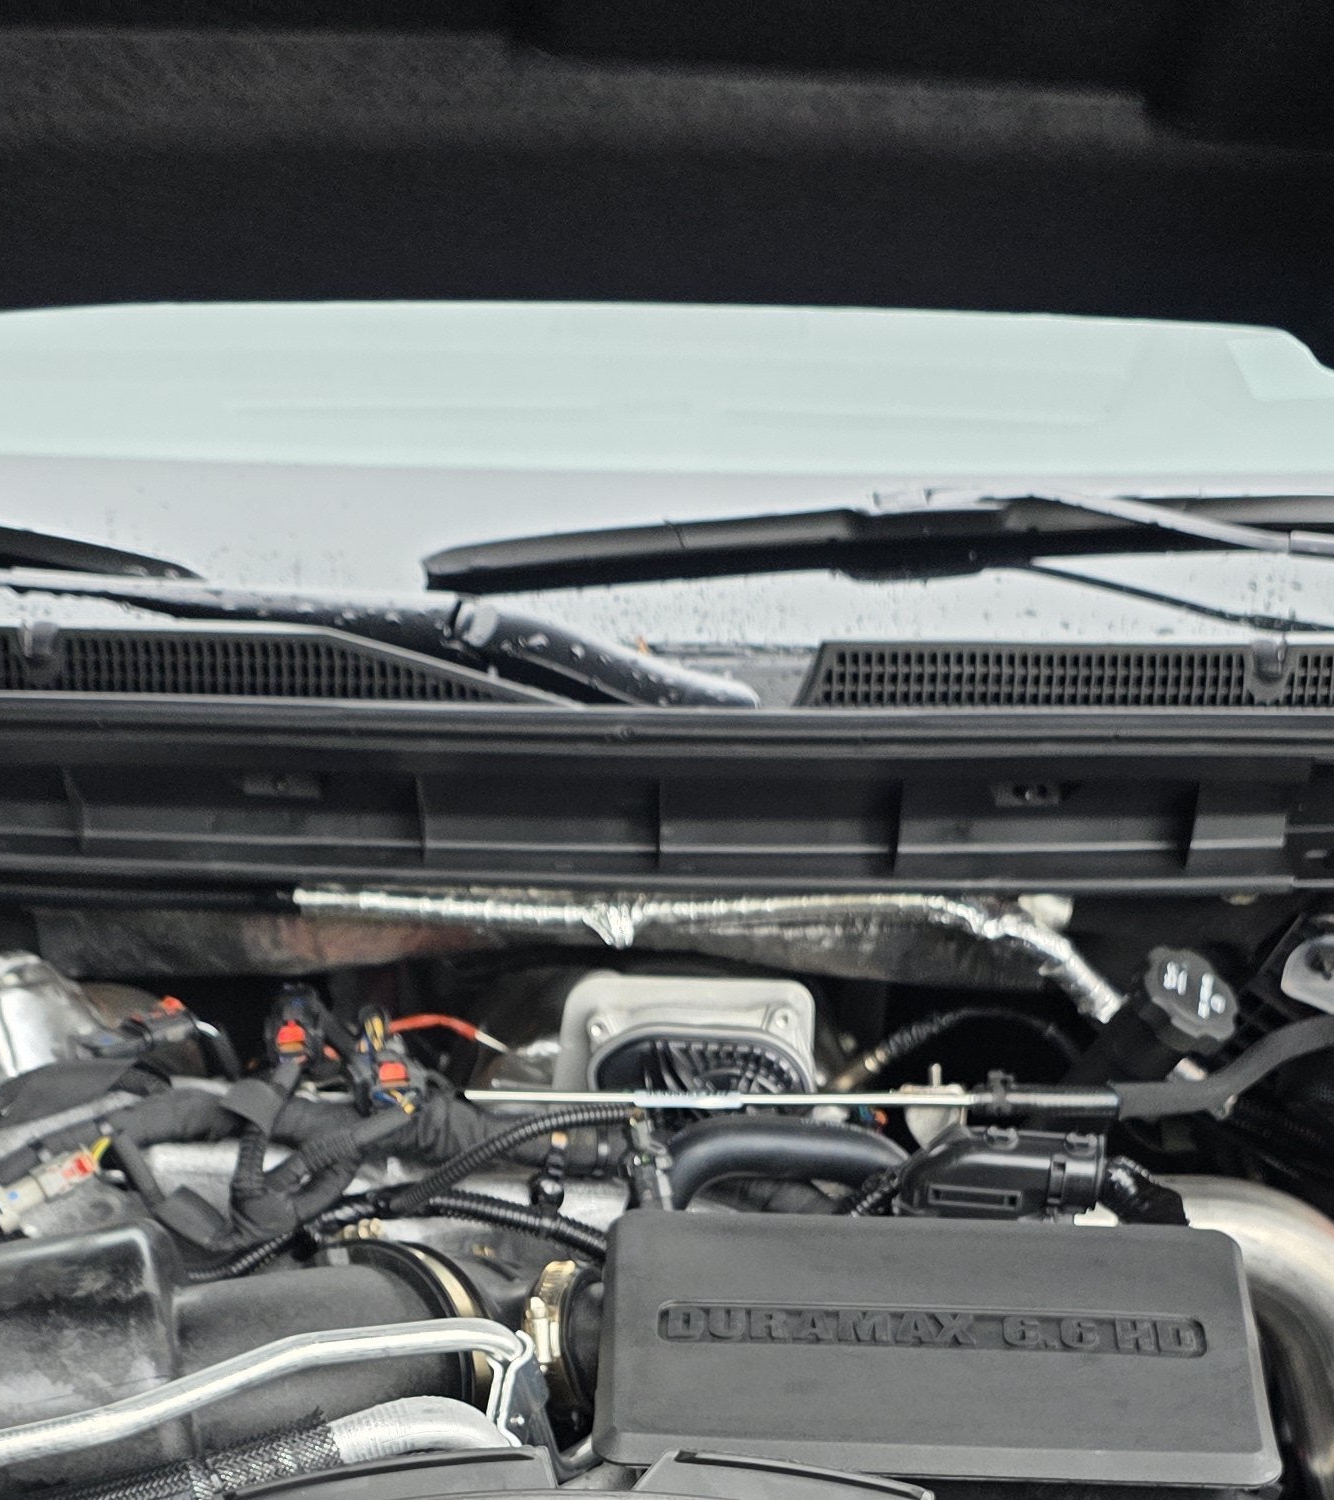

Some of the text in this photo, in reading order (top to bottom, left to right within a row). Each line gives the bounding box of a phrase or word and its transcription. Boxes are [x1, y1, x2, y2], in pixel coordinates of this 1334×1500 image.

[666, 1307, 1199, 1353] DURAMAX 6.6 HD
